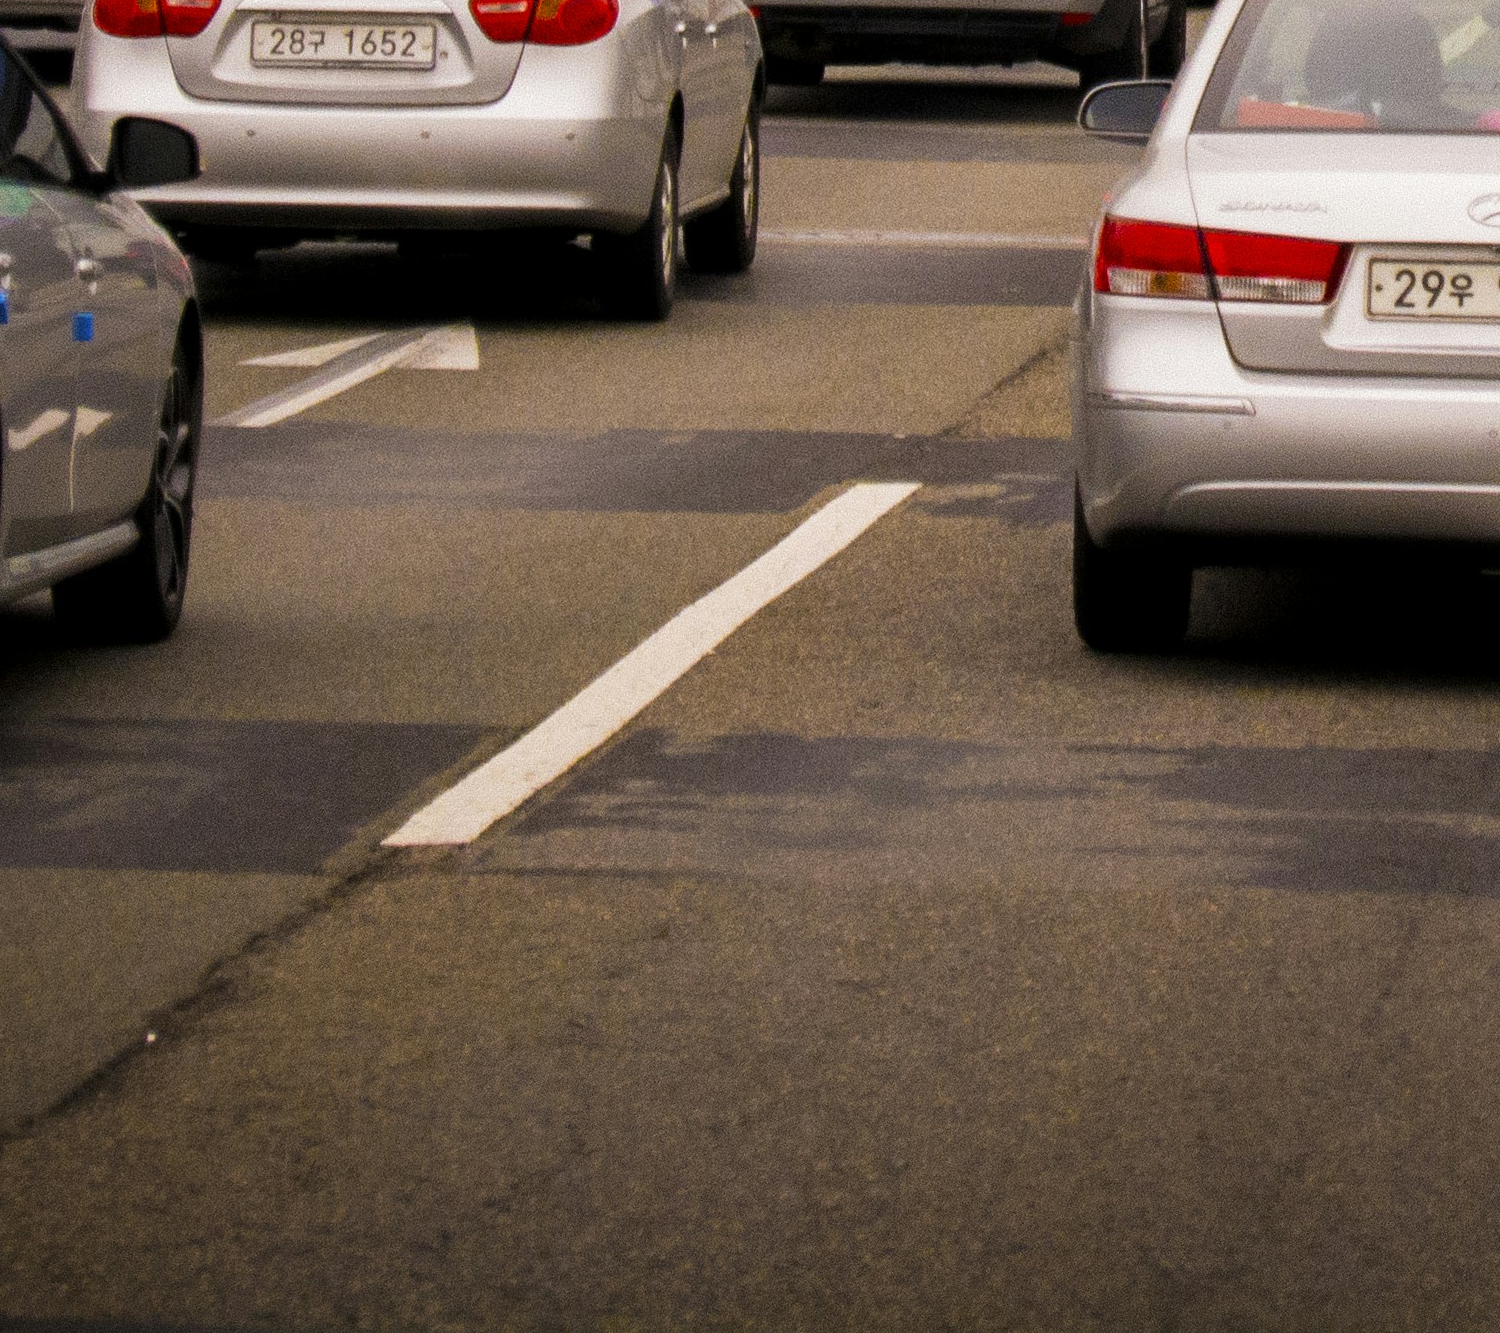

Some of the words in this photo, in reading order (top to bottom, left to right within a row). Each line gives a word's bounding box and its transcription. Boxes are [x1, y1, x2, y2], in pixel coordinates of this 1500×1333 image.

[270, 28, 326, 55] 28구
[343, 29, 417, 57] 1652
[1393, 268, 1474, 309] 29우
